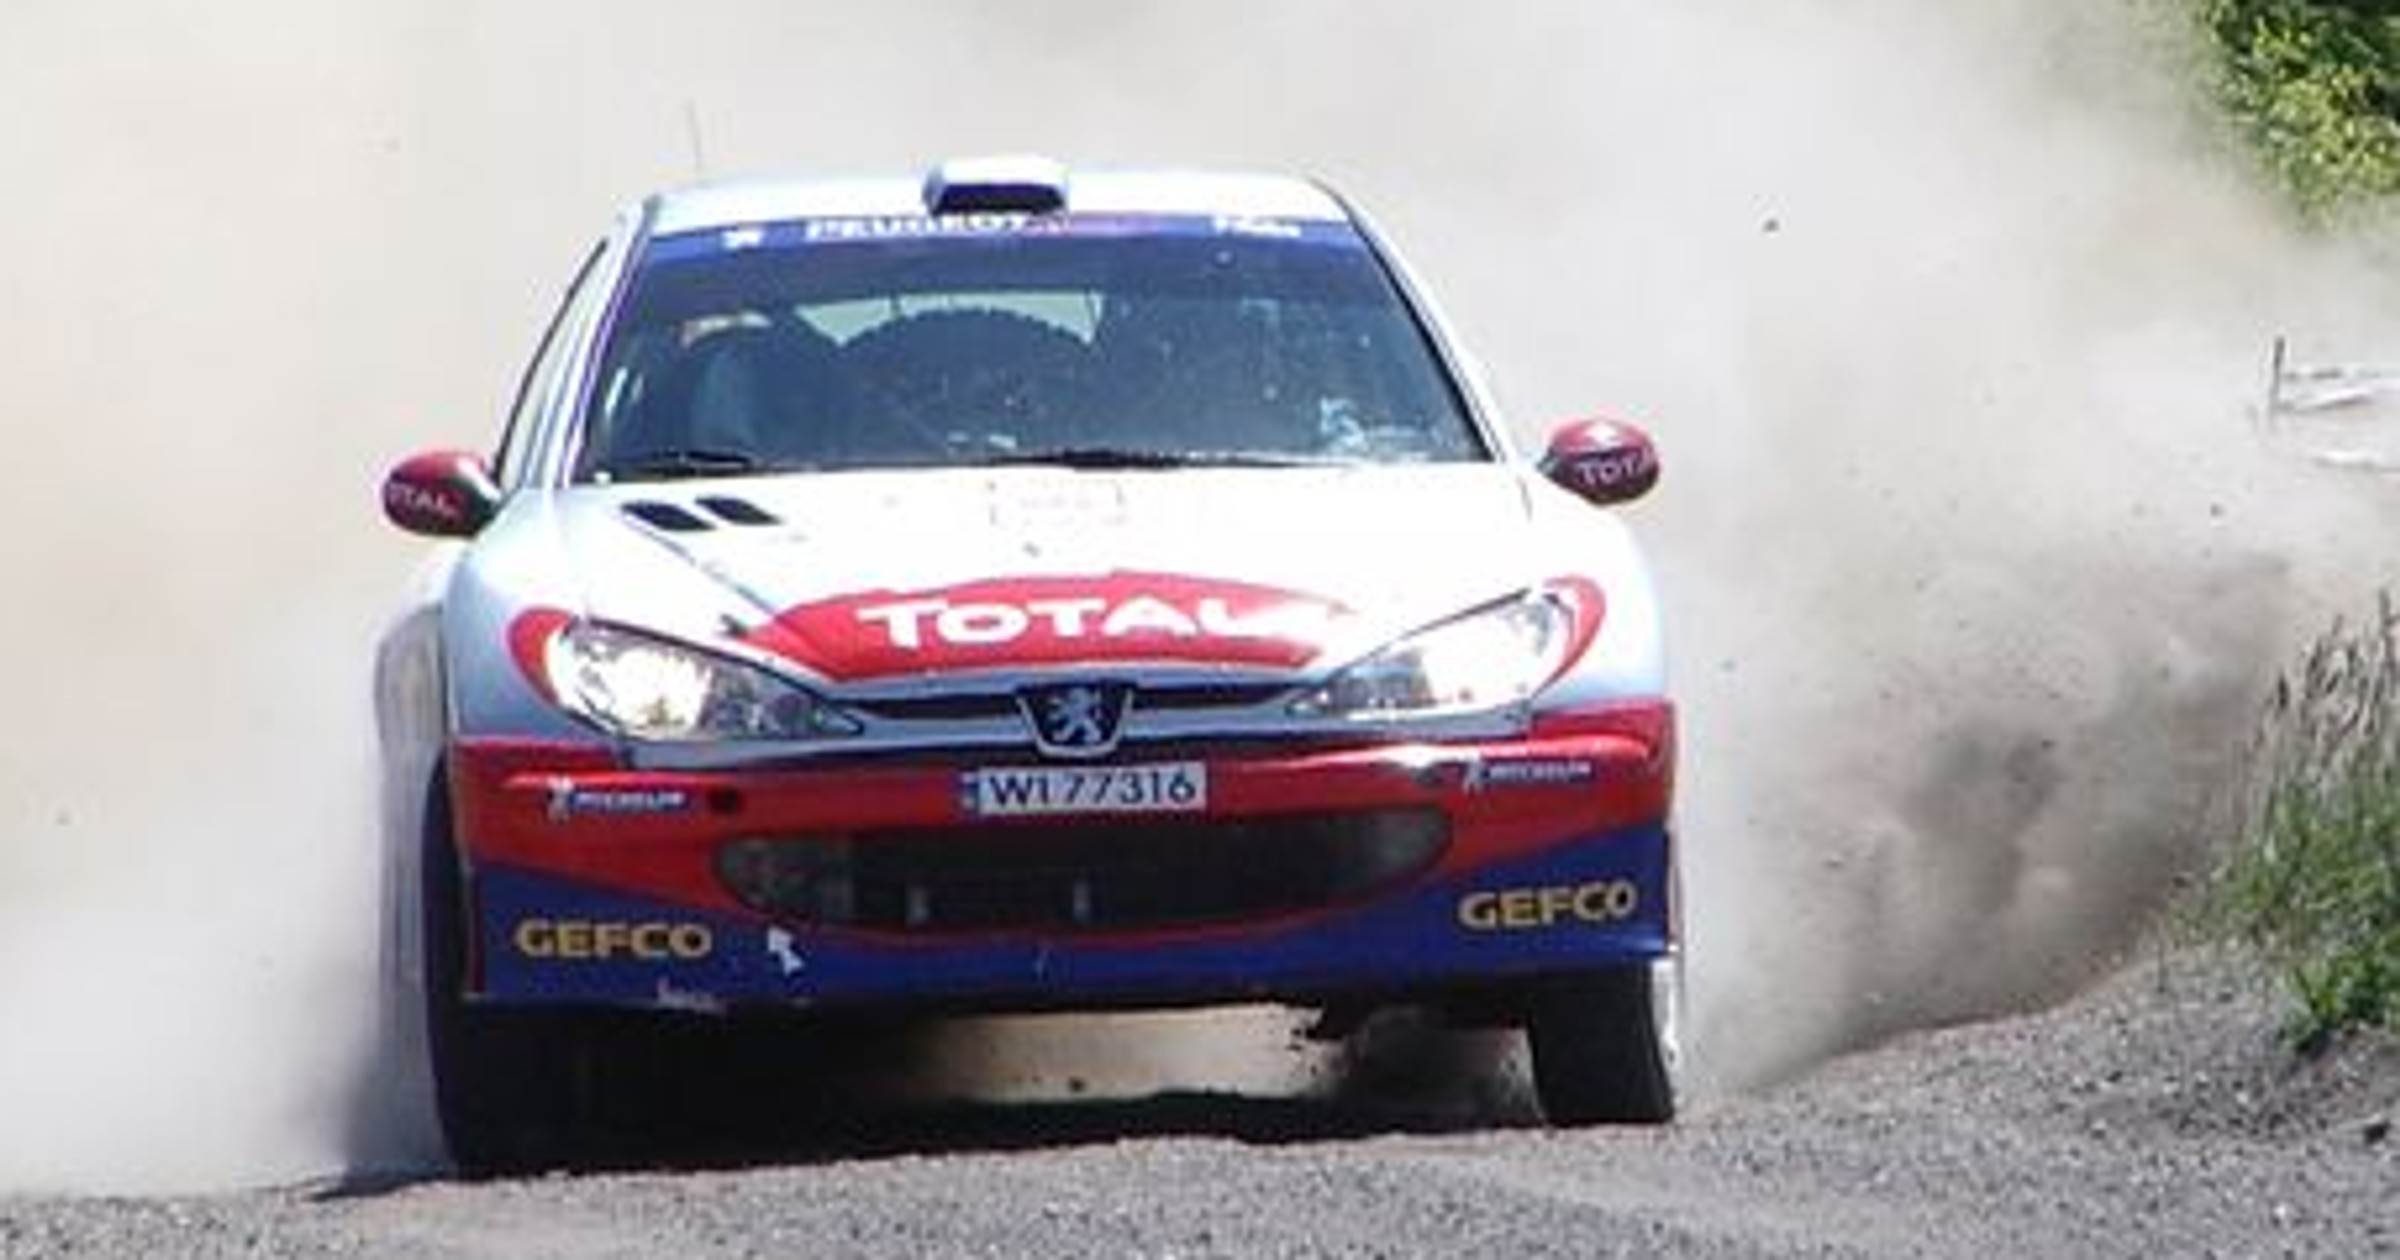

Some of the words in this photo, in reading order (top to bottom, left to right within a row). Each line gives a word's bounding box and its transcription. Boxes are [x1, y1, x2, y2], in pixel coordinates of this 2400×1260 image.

[857, 593, 1285, 650] TOTAL
[1458, 879, 1639, 931] GEFCO
[516, 919, 713, 958] GEFCO
